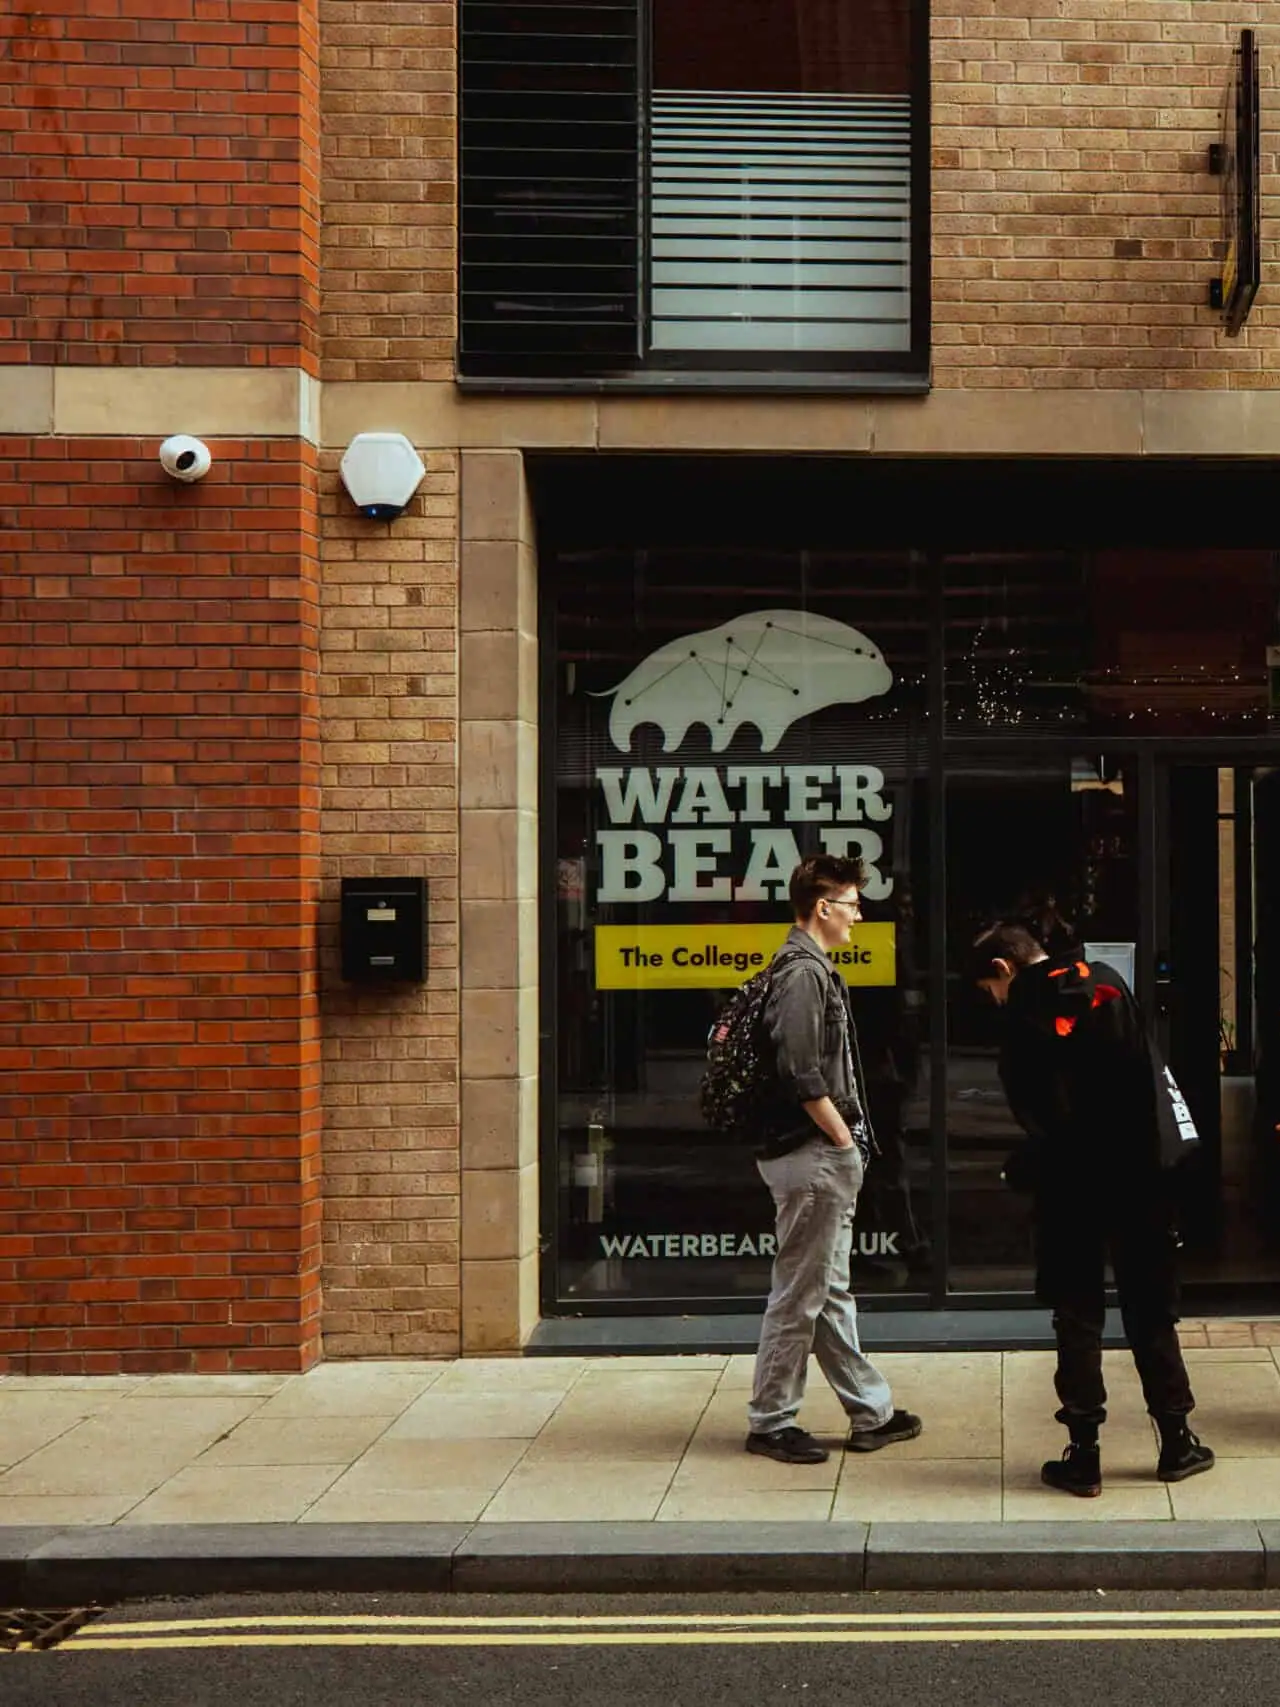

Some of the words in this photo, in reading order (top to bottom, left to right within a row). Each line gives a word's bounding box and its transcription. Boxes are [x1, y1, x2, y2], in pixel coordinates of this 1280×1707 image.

[595, 764, 893, 824] WATER
[596, 828, 894, 903] BEAR
[619, 946, 664, 968] The
[671, 944, 764, 971] College
[826, 944, 872, 964] usic
